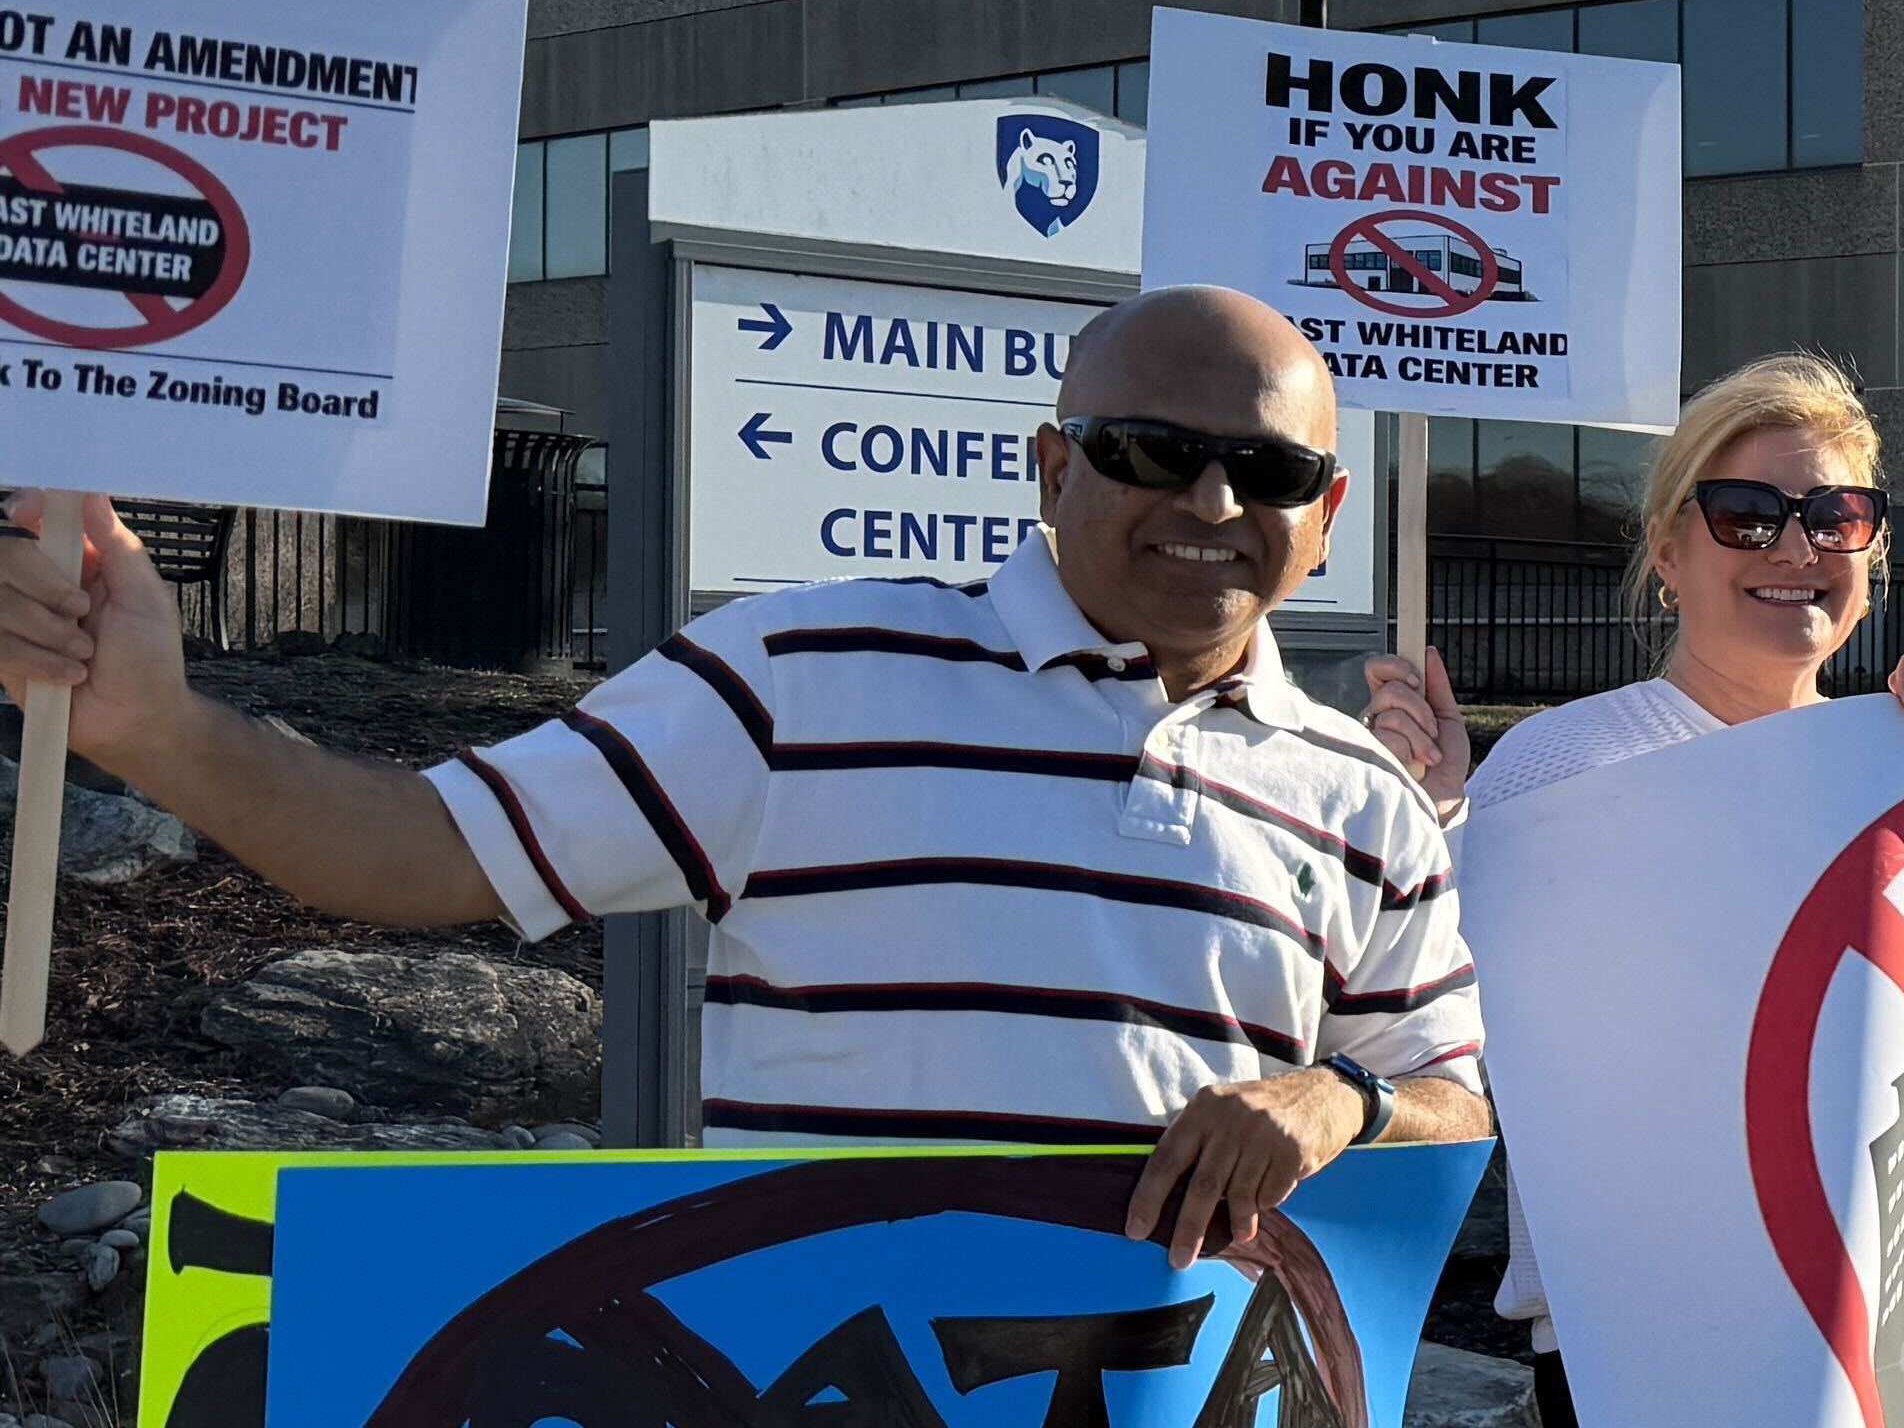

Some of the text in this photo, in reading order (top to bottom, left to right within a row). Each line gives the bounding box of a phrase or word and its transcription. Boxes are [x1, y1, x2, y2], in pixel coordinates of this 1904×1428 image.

[0, 10, 417, 103] OT AN AMENDMENT
[18, 75, 348, 152] NEW PROJECT
[1265, 52, 1558, 129] HONK
[1289, 117, 1537, 164] IF YOU ARE
[1261, 155, 1561, 214] AGAINST
[0, 194, 219, 248] AST WHITELAND
[77, 243, 193, 282] CENTER
[823, 311, 1077, 380] MAIN BU
[1284, 315, 1568, 357] ST WHITELAND
[22, 358, 62, 391] To
[74, 363, 137, 398] The
[146, 371, 266, 415] Zoning
[277, 386, 379, 420] Board
[1322, 352, 1540, 388] ATA CENTER
[821, 422, 1037, 482] CONFE
